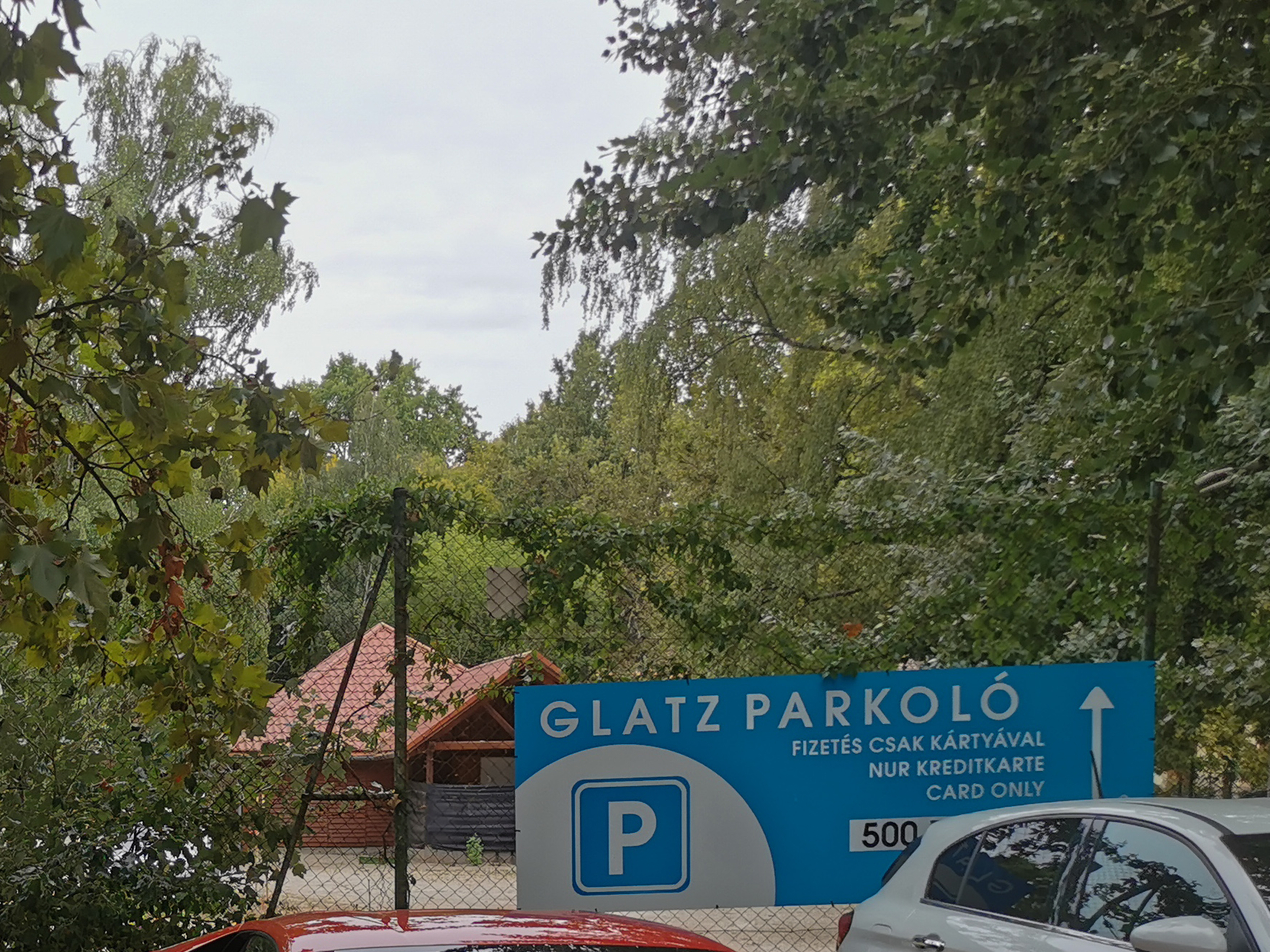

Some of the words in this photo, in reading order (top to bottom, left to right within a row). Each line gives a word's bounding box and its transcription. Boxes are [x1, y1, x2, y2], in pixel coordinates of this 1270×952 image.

[540, 695, 720, 739] GLATZ
[746, 671, 1019, 730] PARKOLÓ
[792, 734, 862, 756] FIZETÉS
[869, 735, 924, 753] CSAK
[930, 727, 1045, 751] KÁRTYÁVAL
[869, 762, 910, 778] NUR
[916, 756, 1045, 777] KREDITKARTE
[926, 783, 985, 801] CARD
[991, 781, 1045, 798] ONLY
[609, 800, 657, 876] P
[861, 820, 918, 848] 500
